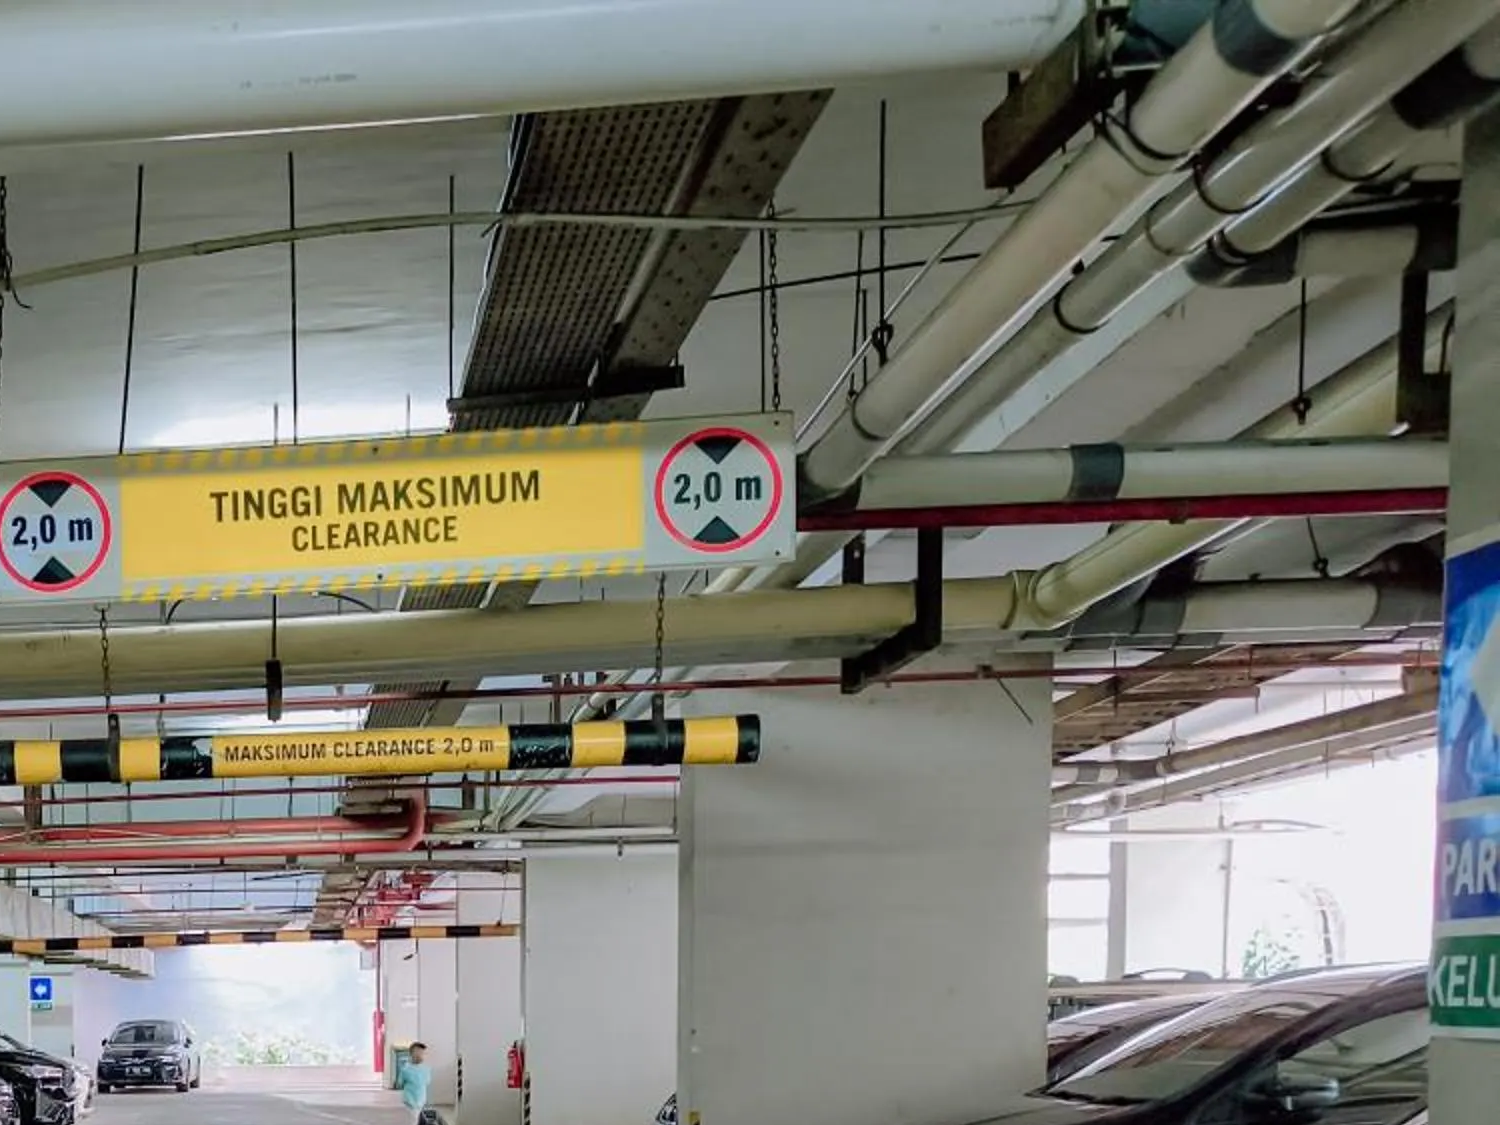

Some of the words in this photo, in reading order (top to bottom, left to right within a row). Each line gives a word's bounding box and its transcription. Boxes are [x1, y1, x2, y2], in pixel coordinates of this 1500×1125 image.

[209, 485, 323, 523] TINGGI
[337, 470, 540, 515] MAKSIMUM
[673, 472, 722, 511] 2,0
[735, 475, 762, 501] m
[11, 514, 57, 551] 2,0
[68, 517, 93, 542] m
[292, 516, 458, 552] CLEARANCE
[224, 742, 326, 763] MAKSIMUM
[333, 738, 436, 759] CLEARANCE
[443, 736, 472, 757] 2,0
[479, 738, 494, 753] m
